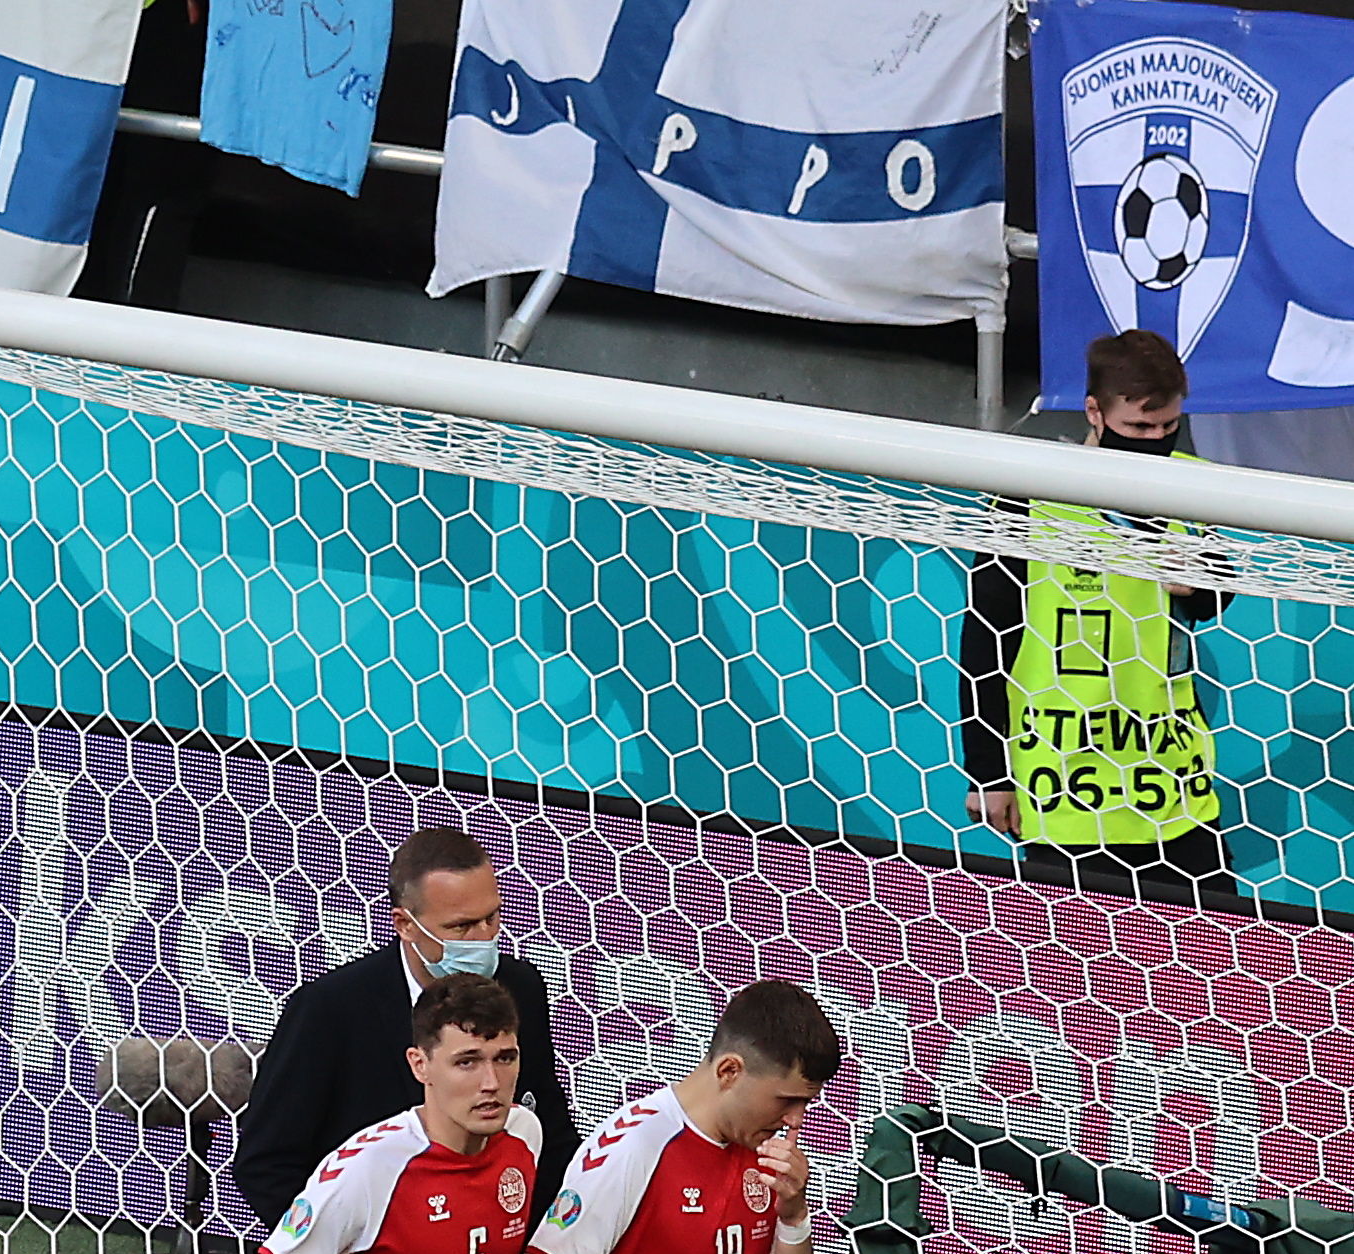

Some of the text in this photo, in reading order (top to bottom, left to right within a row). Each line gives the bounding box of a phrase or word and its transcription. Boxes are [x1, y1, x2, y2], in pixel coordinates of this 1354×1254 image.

[1068, 53, 1267, 115] SUOMEN MAAJOUKKUEEN
[1110, 80, 1230, 115] KANNATTAJAT
[1147, 126, 1188, 147] 2002
